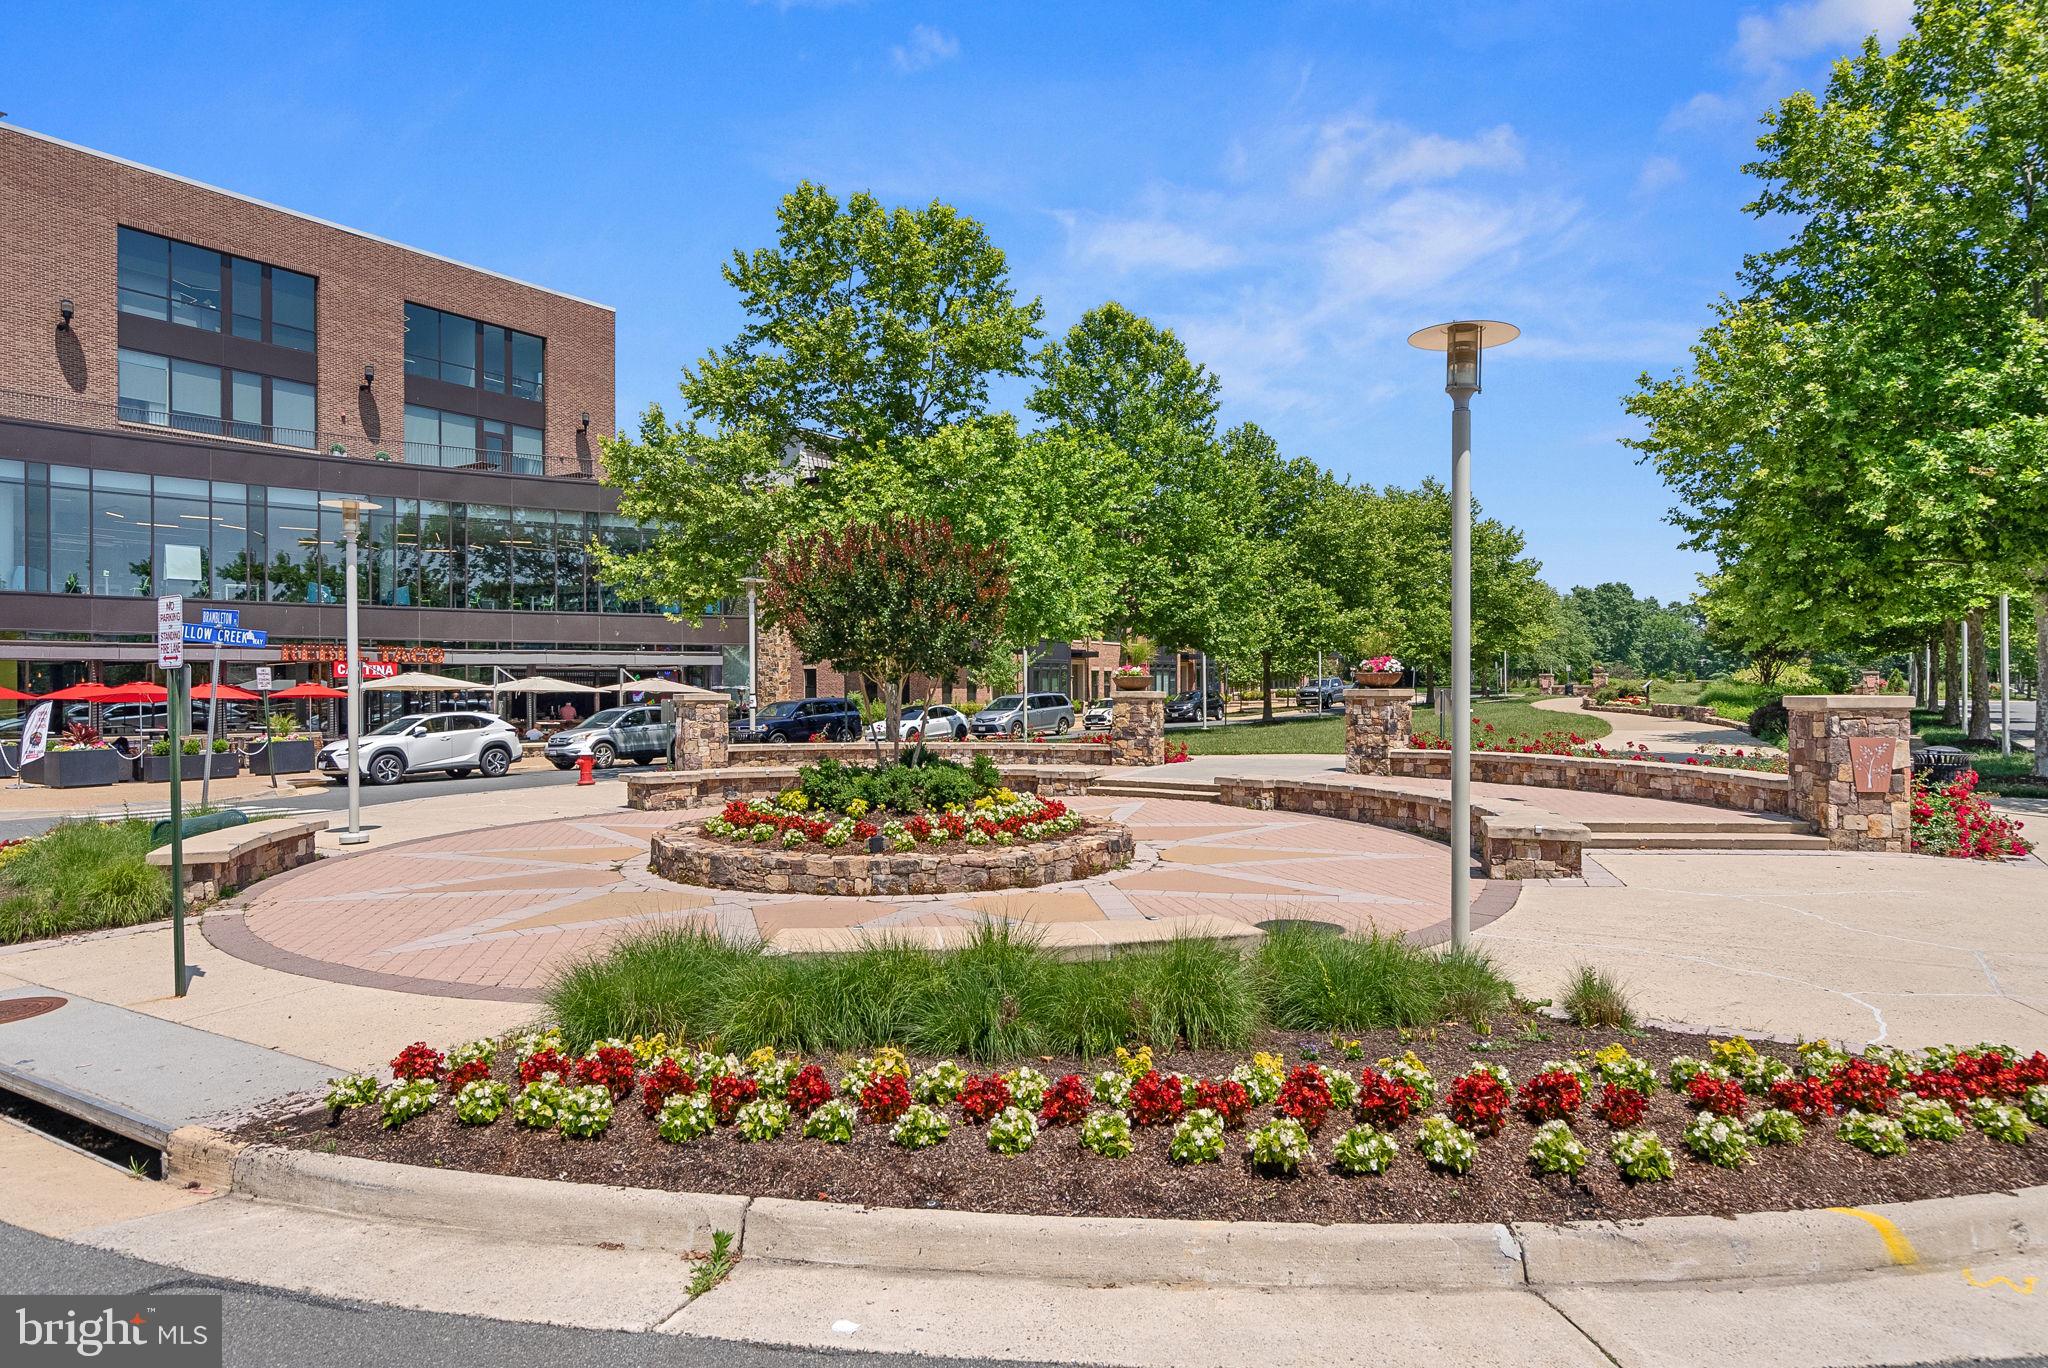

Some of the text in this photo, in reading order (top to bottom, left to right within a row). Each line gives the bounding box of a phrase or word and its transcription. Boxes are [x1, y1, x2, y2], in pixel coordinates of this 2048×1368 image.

[165, 601, 175, 611] NO
[160, 612, 181, 623] PARKING
[202, 611, 232, 624] BRAMBLETON
[160, 631, 181, 642] STANDING
[182, 625, 264, 646] ILLOW CREEK WAY
[160, 642, 181, 654] FIRE LANE
[378, 645, 446, 664] TACO
[337, 662, 394, 676] CTINA
